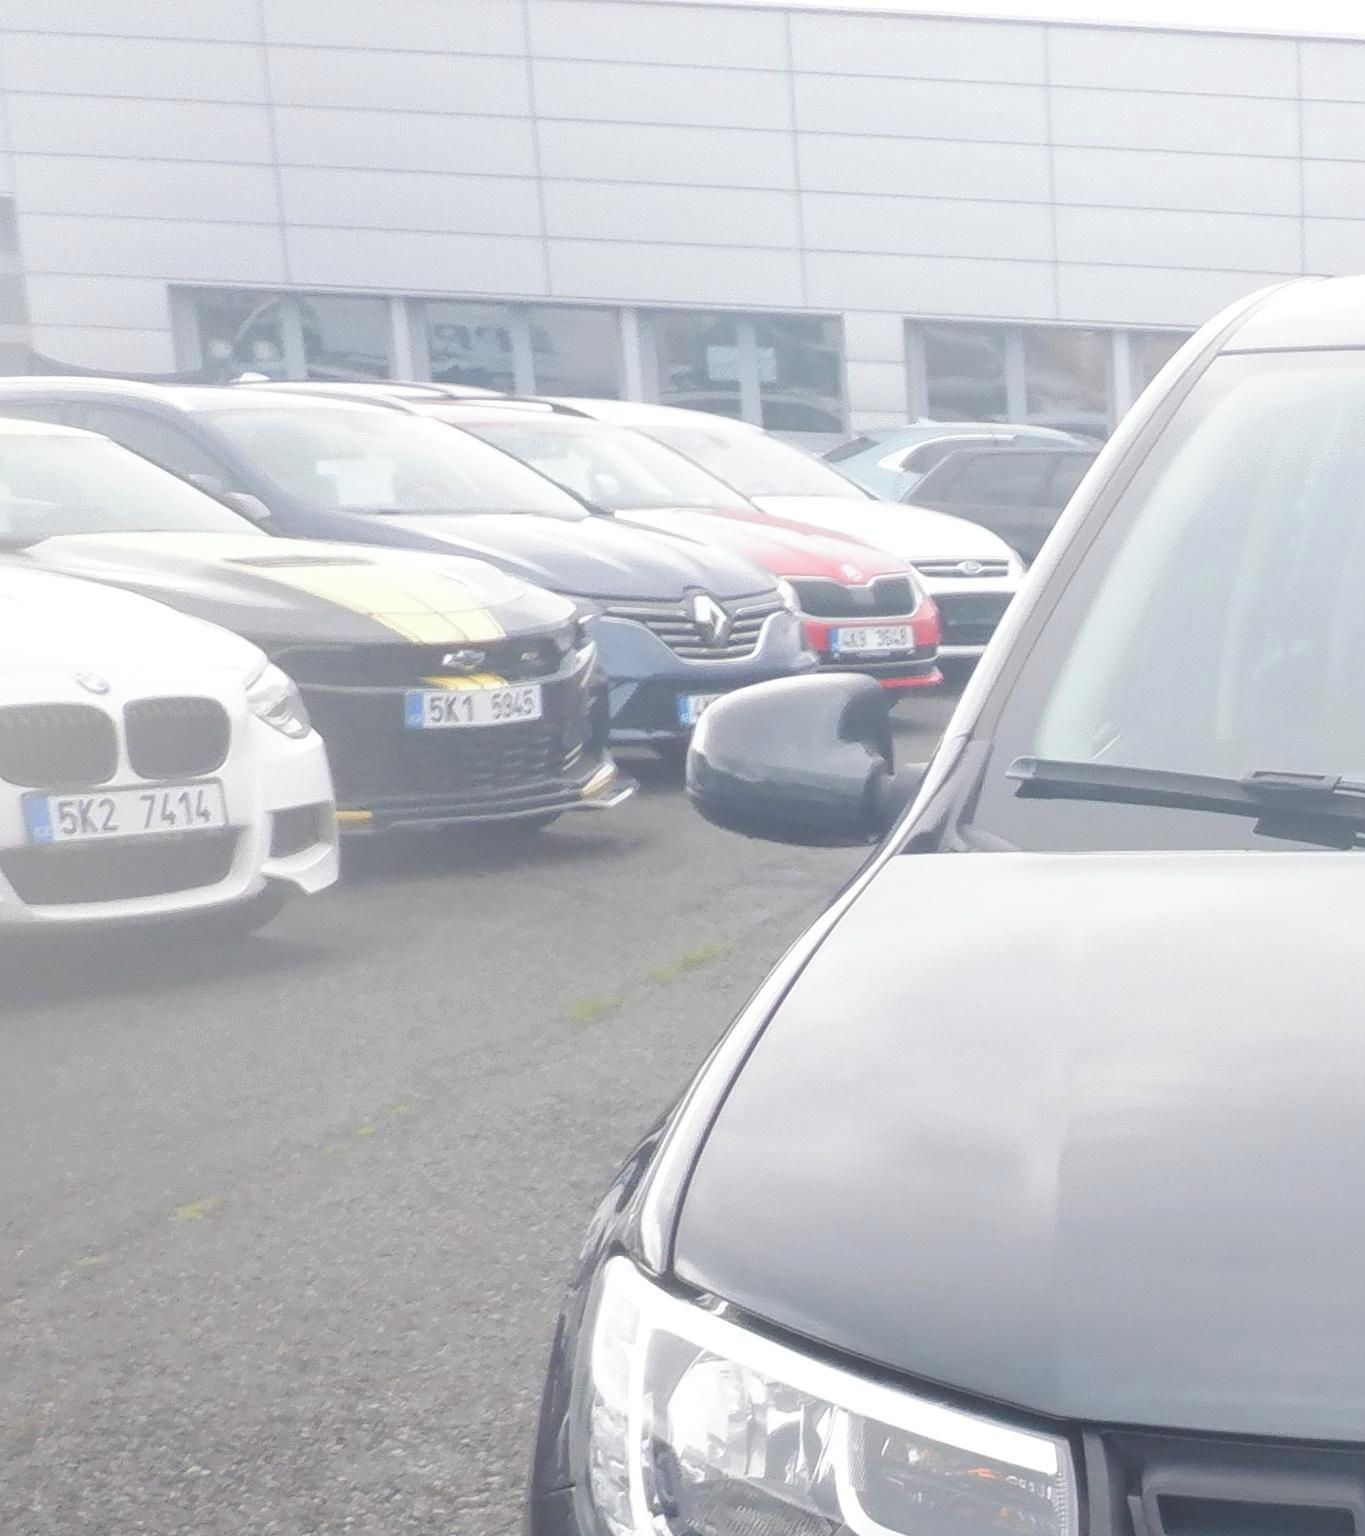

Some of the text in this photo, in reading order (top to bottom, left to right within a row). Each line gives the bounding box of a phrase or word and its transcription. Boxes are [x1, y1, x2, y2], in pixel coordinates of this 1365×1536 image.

[429, 695, 474, 723] 5K1
[58, 798, 119, 835] 5K2
[139, 789, 211, 829] 7414
